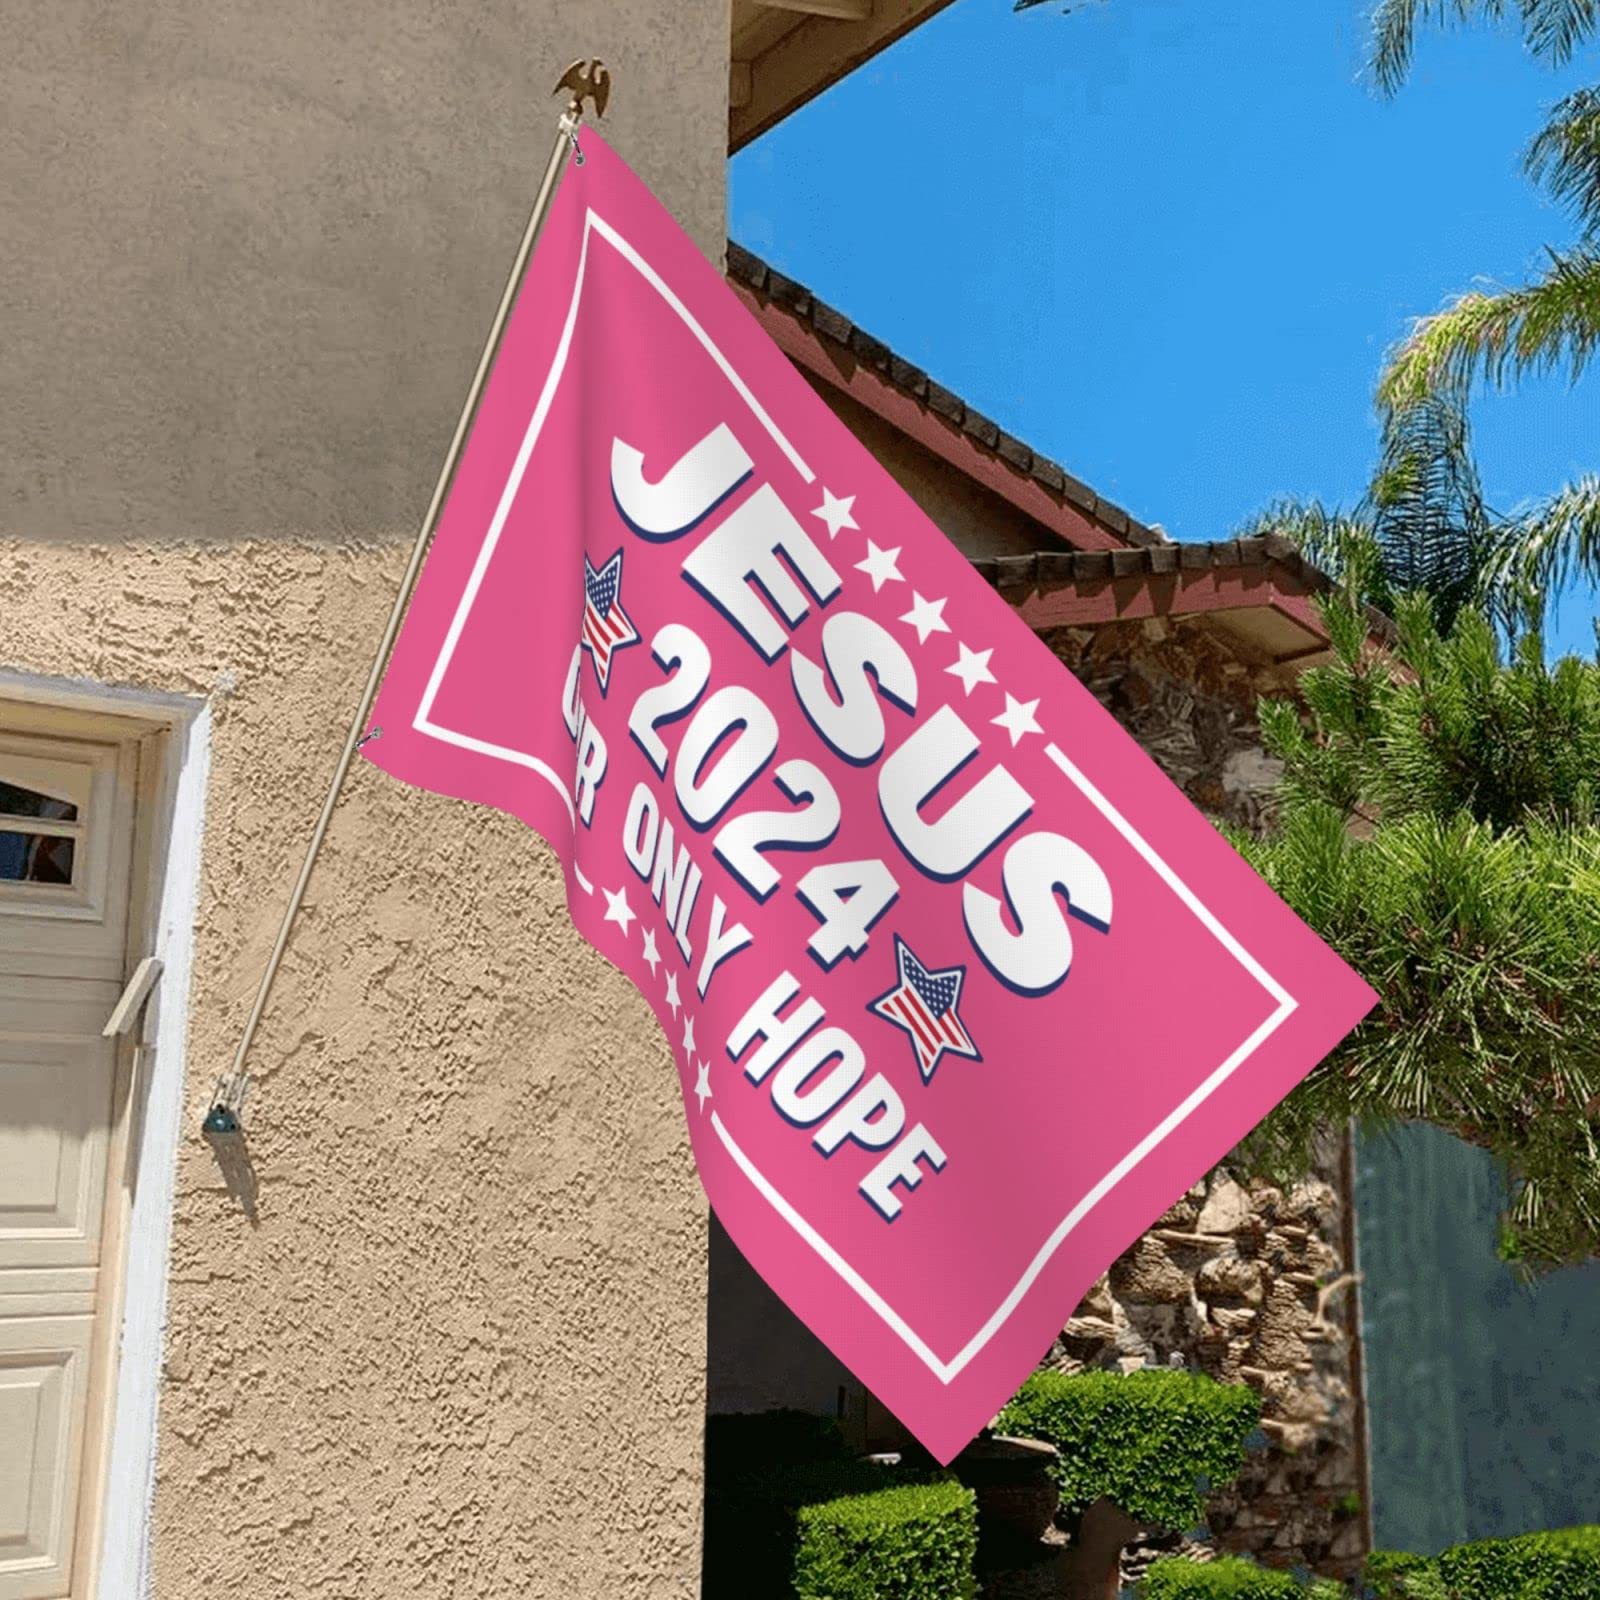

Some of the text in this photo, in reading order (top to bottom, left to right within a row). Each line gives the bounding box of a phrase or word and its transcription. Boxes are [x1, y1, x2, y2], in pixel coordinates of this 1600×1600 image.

[611, 422, 1113, 997] JESUS
[628, 624, 900, 971] 2024
[623, 782, 754, 1002] ONLY
[726, 970, 948, 1223] HOPE
